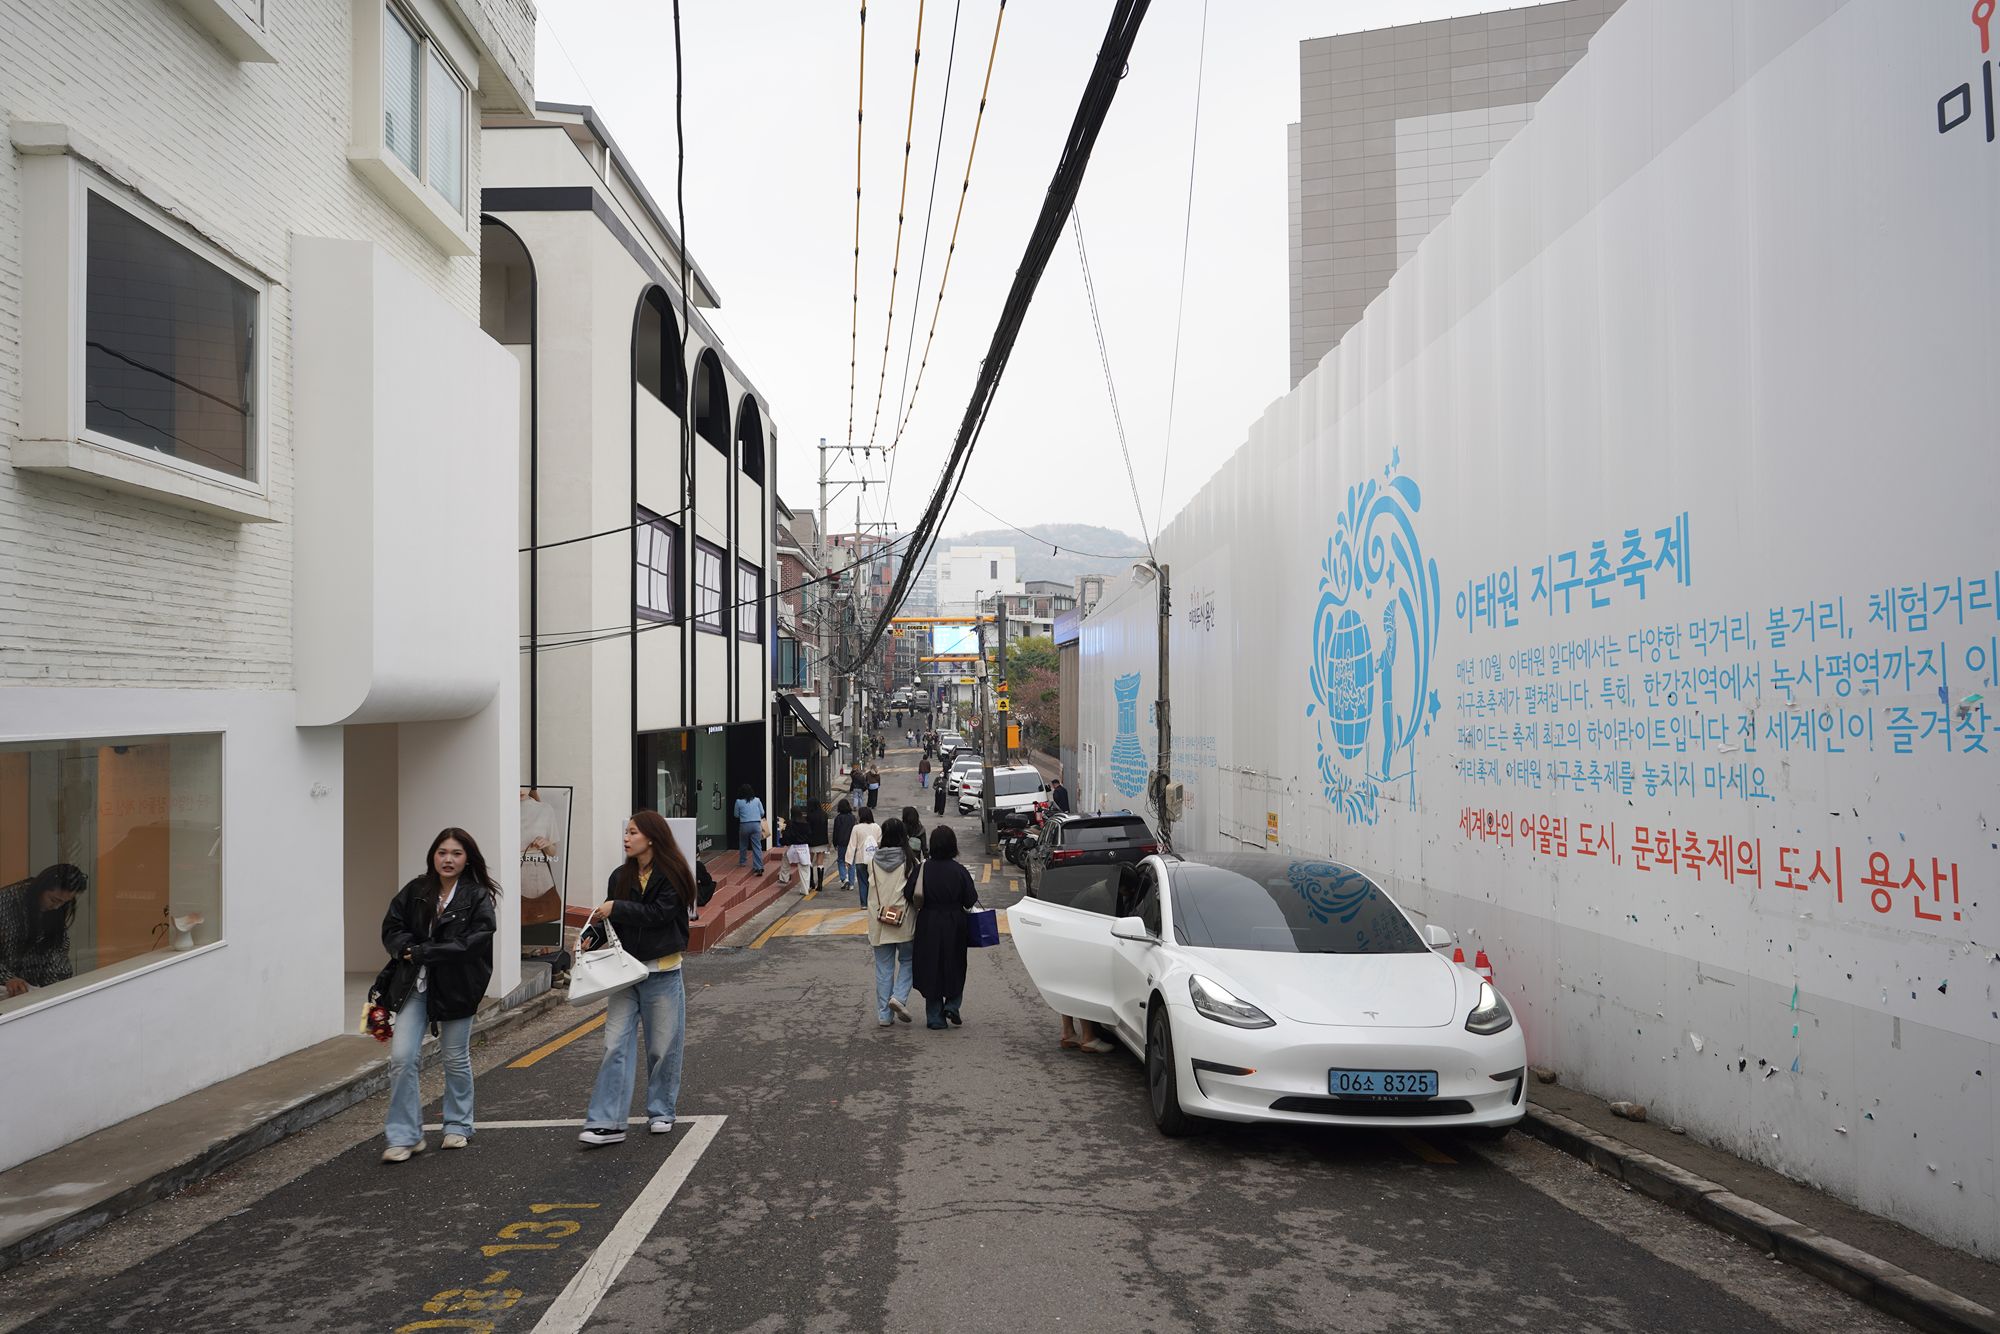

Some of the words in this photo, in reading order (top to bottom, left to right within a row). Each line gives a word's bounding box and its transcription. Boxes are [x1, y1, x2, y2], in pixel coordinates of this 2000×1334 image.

[1937, 60, 2000, 143] 미
[1456, 564, 1519, 633] 이태원
[1531, 512, 1691, 616] 지구촌축제
[1456, 657, 1475, 685] 매년
[1479, 653, 1504, 682] 10월,
[1509, 646, 1545, 678] 이태원
[1549, 635, 1622, 675] 일대에서는
[1627, 623, 1682, 663] 다양한
[1689, 611, 1757, 657] 먹거리,
[1765, 595, 1854, 649] 볼거리,
[1868, 570, 2000, 633] 체험거리
[1456, 686, 1520, 718] 지구촌축제가
[1525, 679, 1593, 715] 펼쳐집니다.
[1600, 673, 1636, 710] 특히,
[1643, 661, 1761, 708] 한강진역에서
[1770, 640, 1949, 702] 녹사평역까지
[1965, 636, 1999, 687] 이
[1457, 723, 1509, 752] 퍼레이드는
[1512, 721, 1538, 752] 축제
[1543, 719, 1582, 751] 최고의
[1587, 713, 1729, 752] 하이라이트입니다
[1737, 713, 1757, 752] 전
[1765, 708, 1873, 753] 세계인이
[1458, 758, 1502, 786] 거리축제,
[1506, 758, 1542, 789] 이태원
[1547, 760, 1635, 795] 지구촌축제를
[1642, 761, 1696, 798] 놓치지
[1704, 762, 1776, 802] 마세요.
[1459, 806, 1514, 848] 세계와의
[1520, 813, 1568, 858] 어울림
[1576, 822, 1622, 866] 도시,
[1632, 826, 1761, 889] 문화축제의
[1775, 846, 1843, 902] 도시
[1861, 851, 1961, 921] 용산!
[1339, 1073, 1375, 1091] 06소
[1384, 1075, 1429, 1093] 8325
